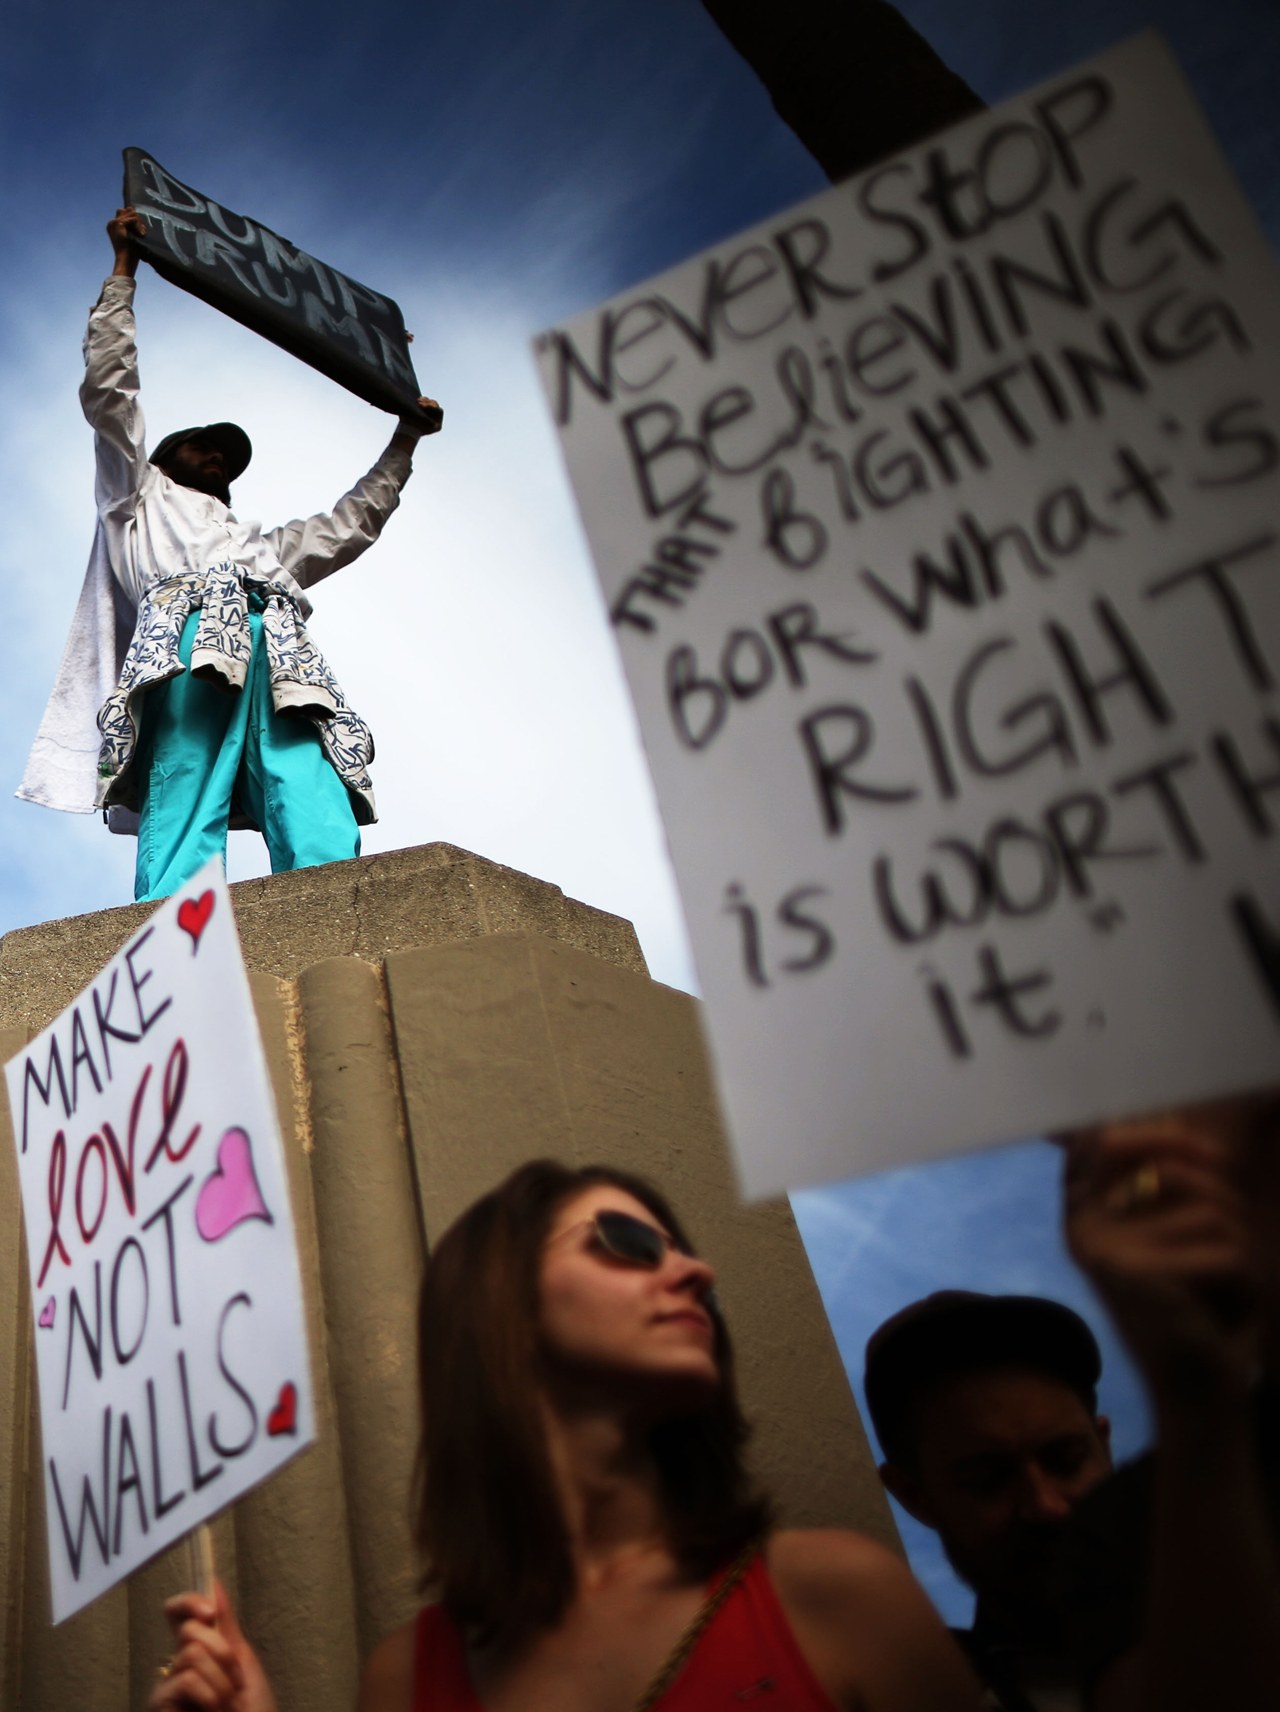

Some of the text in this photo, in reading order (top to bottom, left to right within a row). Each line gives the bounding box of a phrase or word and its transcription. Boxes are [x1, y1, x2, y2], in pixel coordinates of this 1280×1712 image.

[140, 158, 391, 320] DUMP
[854, 72, 1115, 284] StOP
[135, 203, 419, 386] TRUMP
[609, 489, 737, 634] THAT
[799, 532, 1279, 837] RIGHT
[724, 714, 1280, 989] is WORTH
[21, 924, 173, 1154] MAKE
[61, 1173, 194, 1412] NOT
[48, 1291, 259, 1582] WALLS
